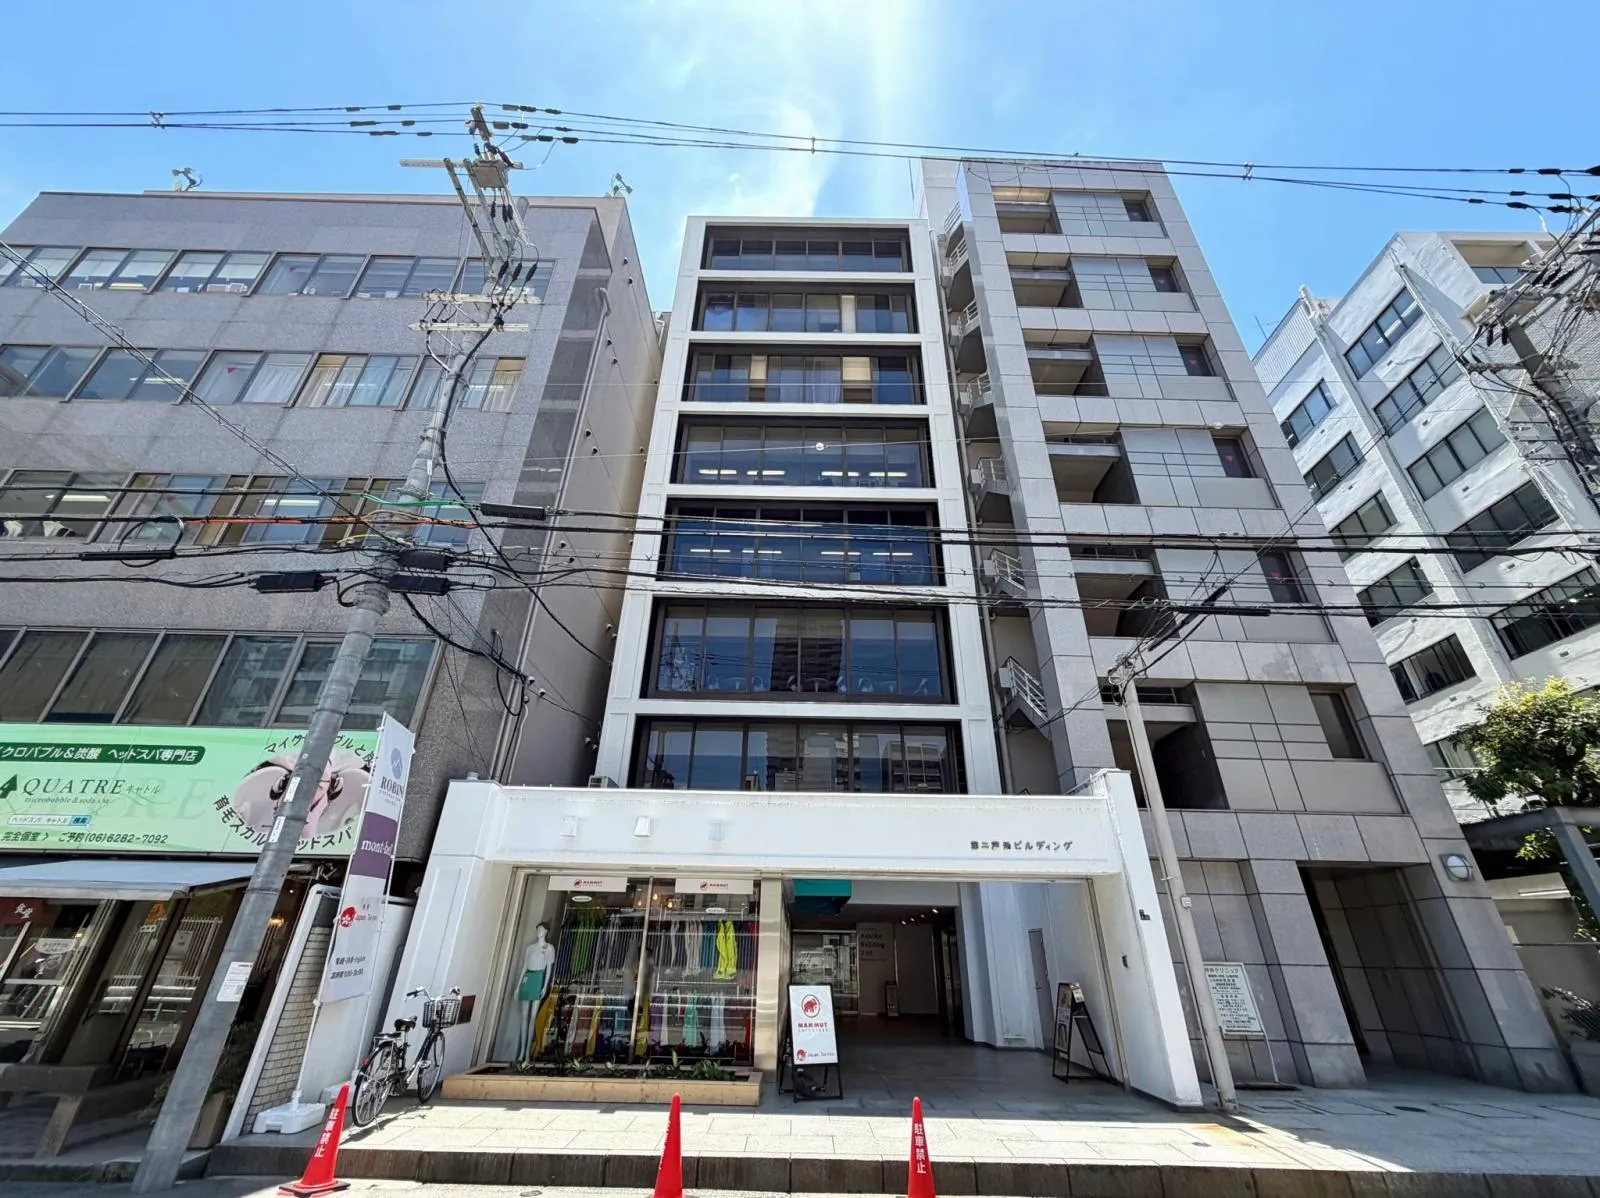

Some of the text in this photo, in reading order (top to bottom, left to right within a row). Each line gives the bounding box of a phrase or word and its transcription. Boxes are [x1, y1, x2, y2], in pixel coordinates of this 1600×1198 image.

[0, 746, 102, 760] クロバブル&炭酸
[23, 778, 125, 796] QUATRE
[126, 784, 160, 794] キャトル
[314, 1107, 340, 1158] 駐車禁止
[914, 1123, 927, 1174] 駐車禁止
